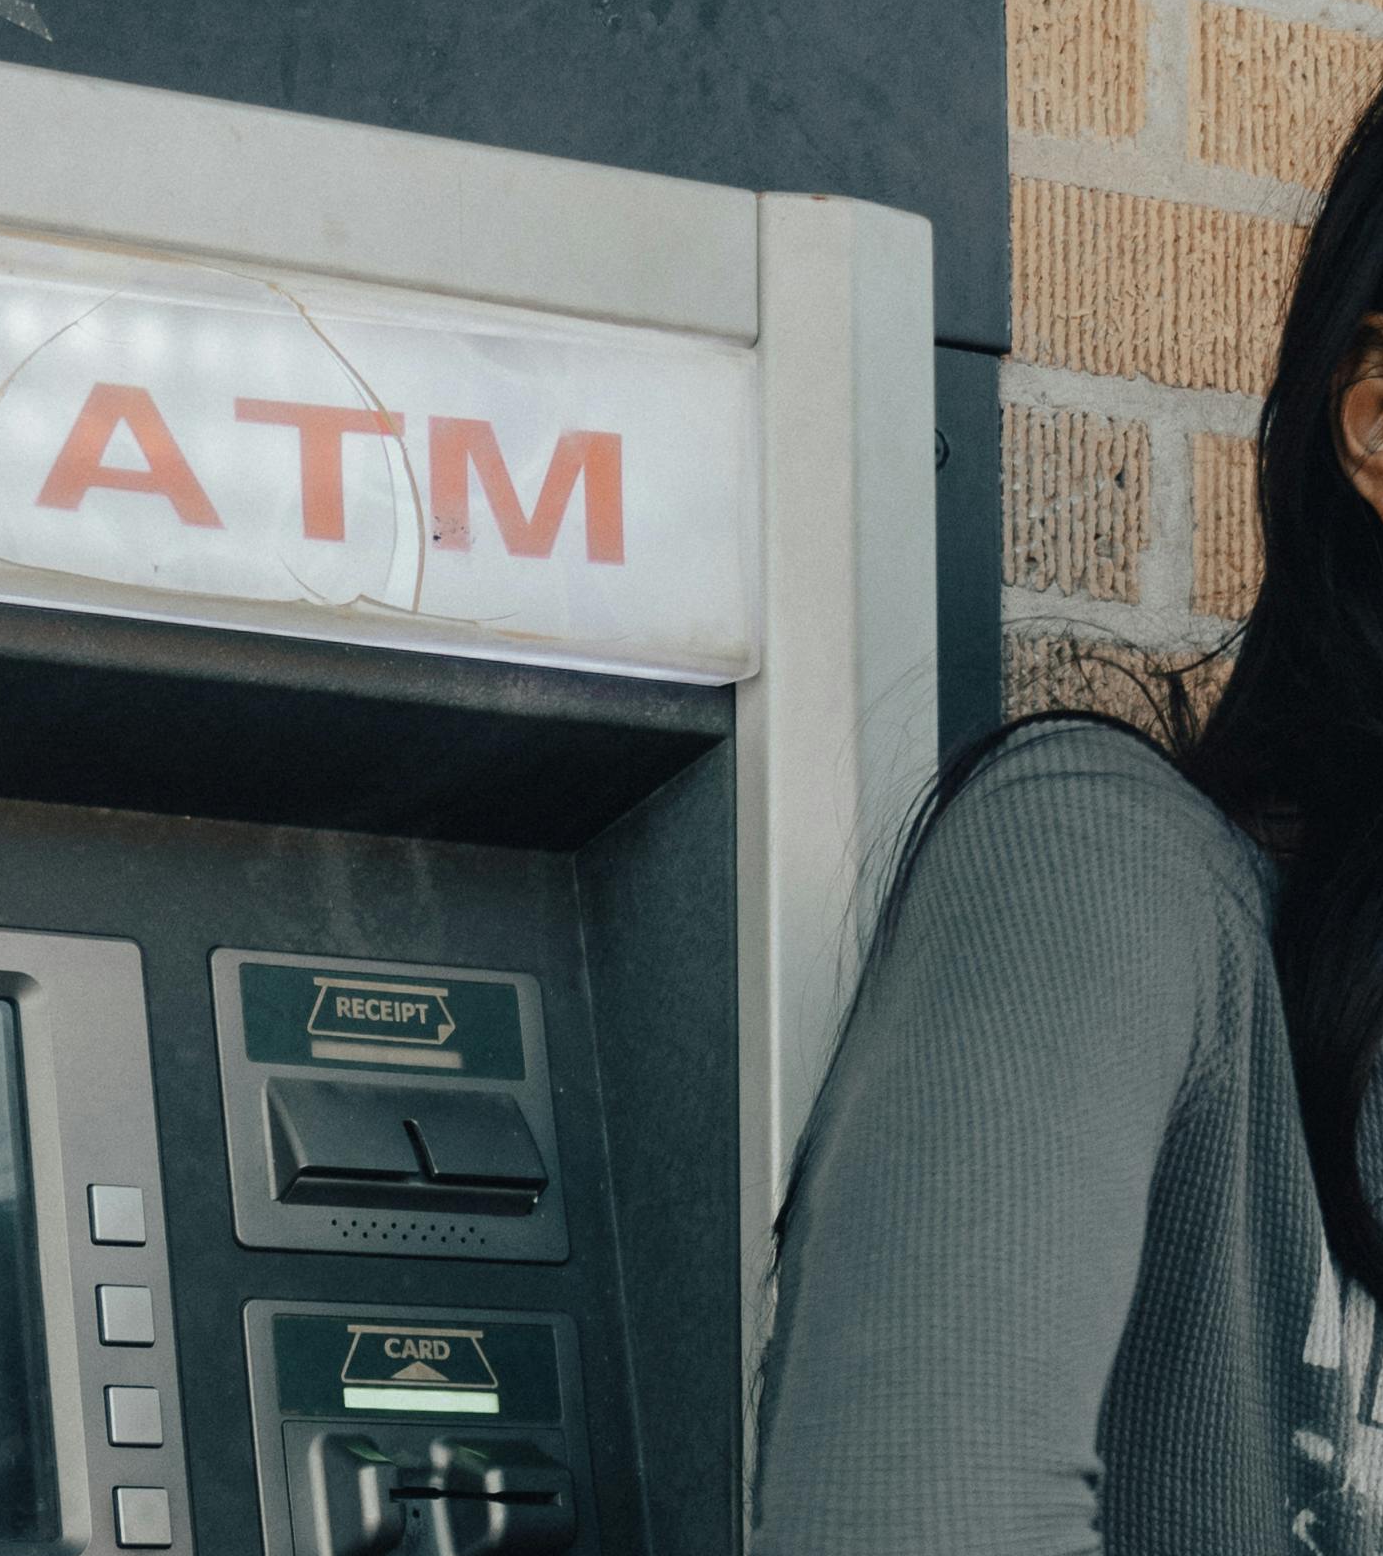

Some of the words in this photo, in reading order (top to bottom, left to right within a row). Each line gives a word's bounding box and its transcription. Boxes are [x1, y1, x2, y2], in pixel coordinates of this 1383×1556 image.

[36, 379, 627, 567] ATM
[336, 996, 429, 1025] RECEIPT
[384, 1337, 451, 1361] CARD
